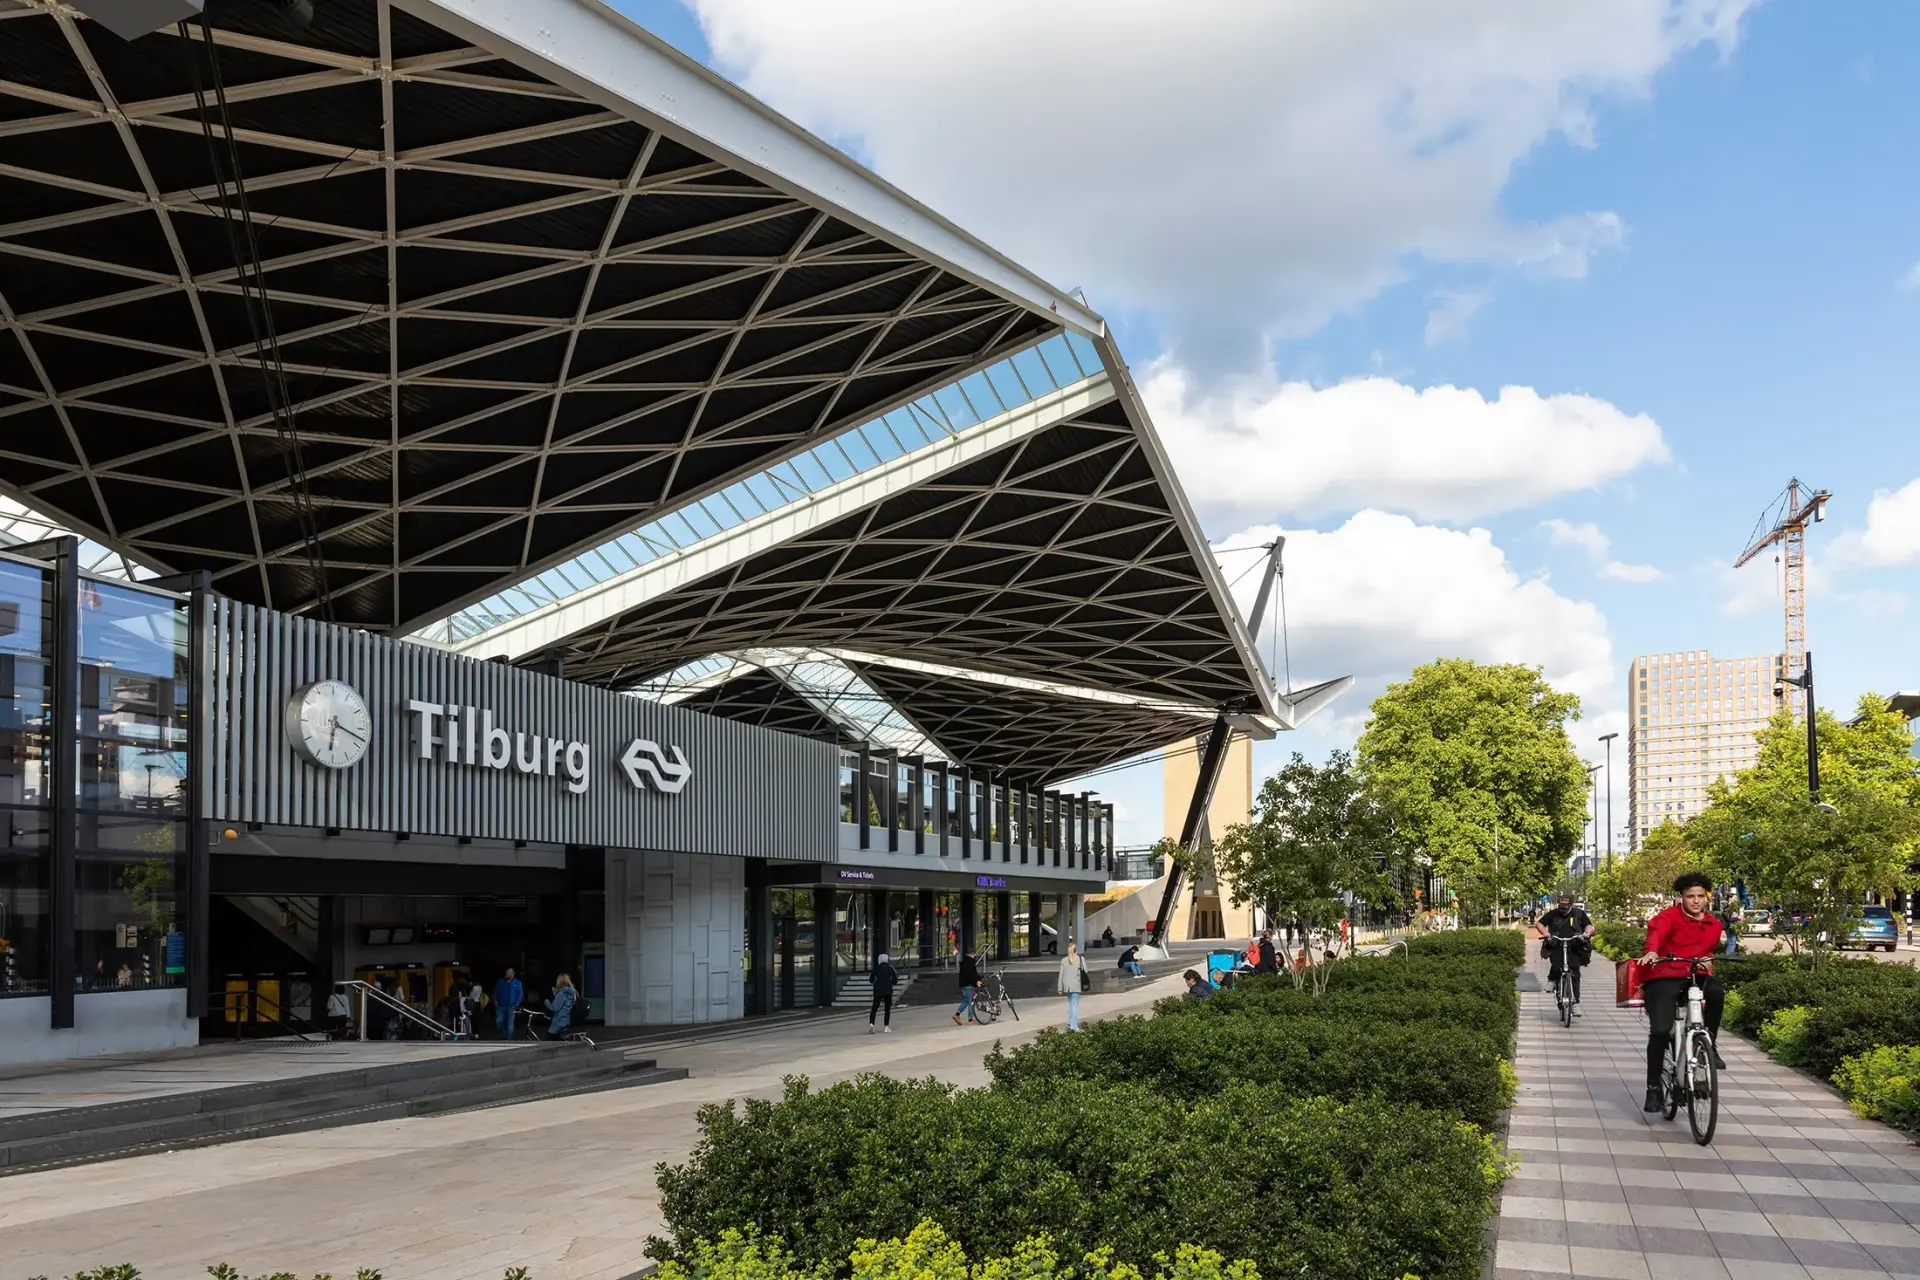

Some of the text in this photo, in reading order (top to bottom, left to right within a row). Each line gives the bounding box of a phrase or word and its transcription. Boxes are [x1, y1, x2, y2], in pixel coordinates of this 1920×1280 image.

[407, 698, 590, 794] Tilburg
[840, 870, 847, 878] OV
[847, 871, 859, 879] Service
[862, 871, 875, 880] Tickets
